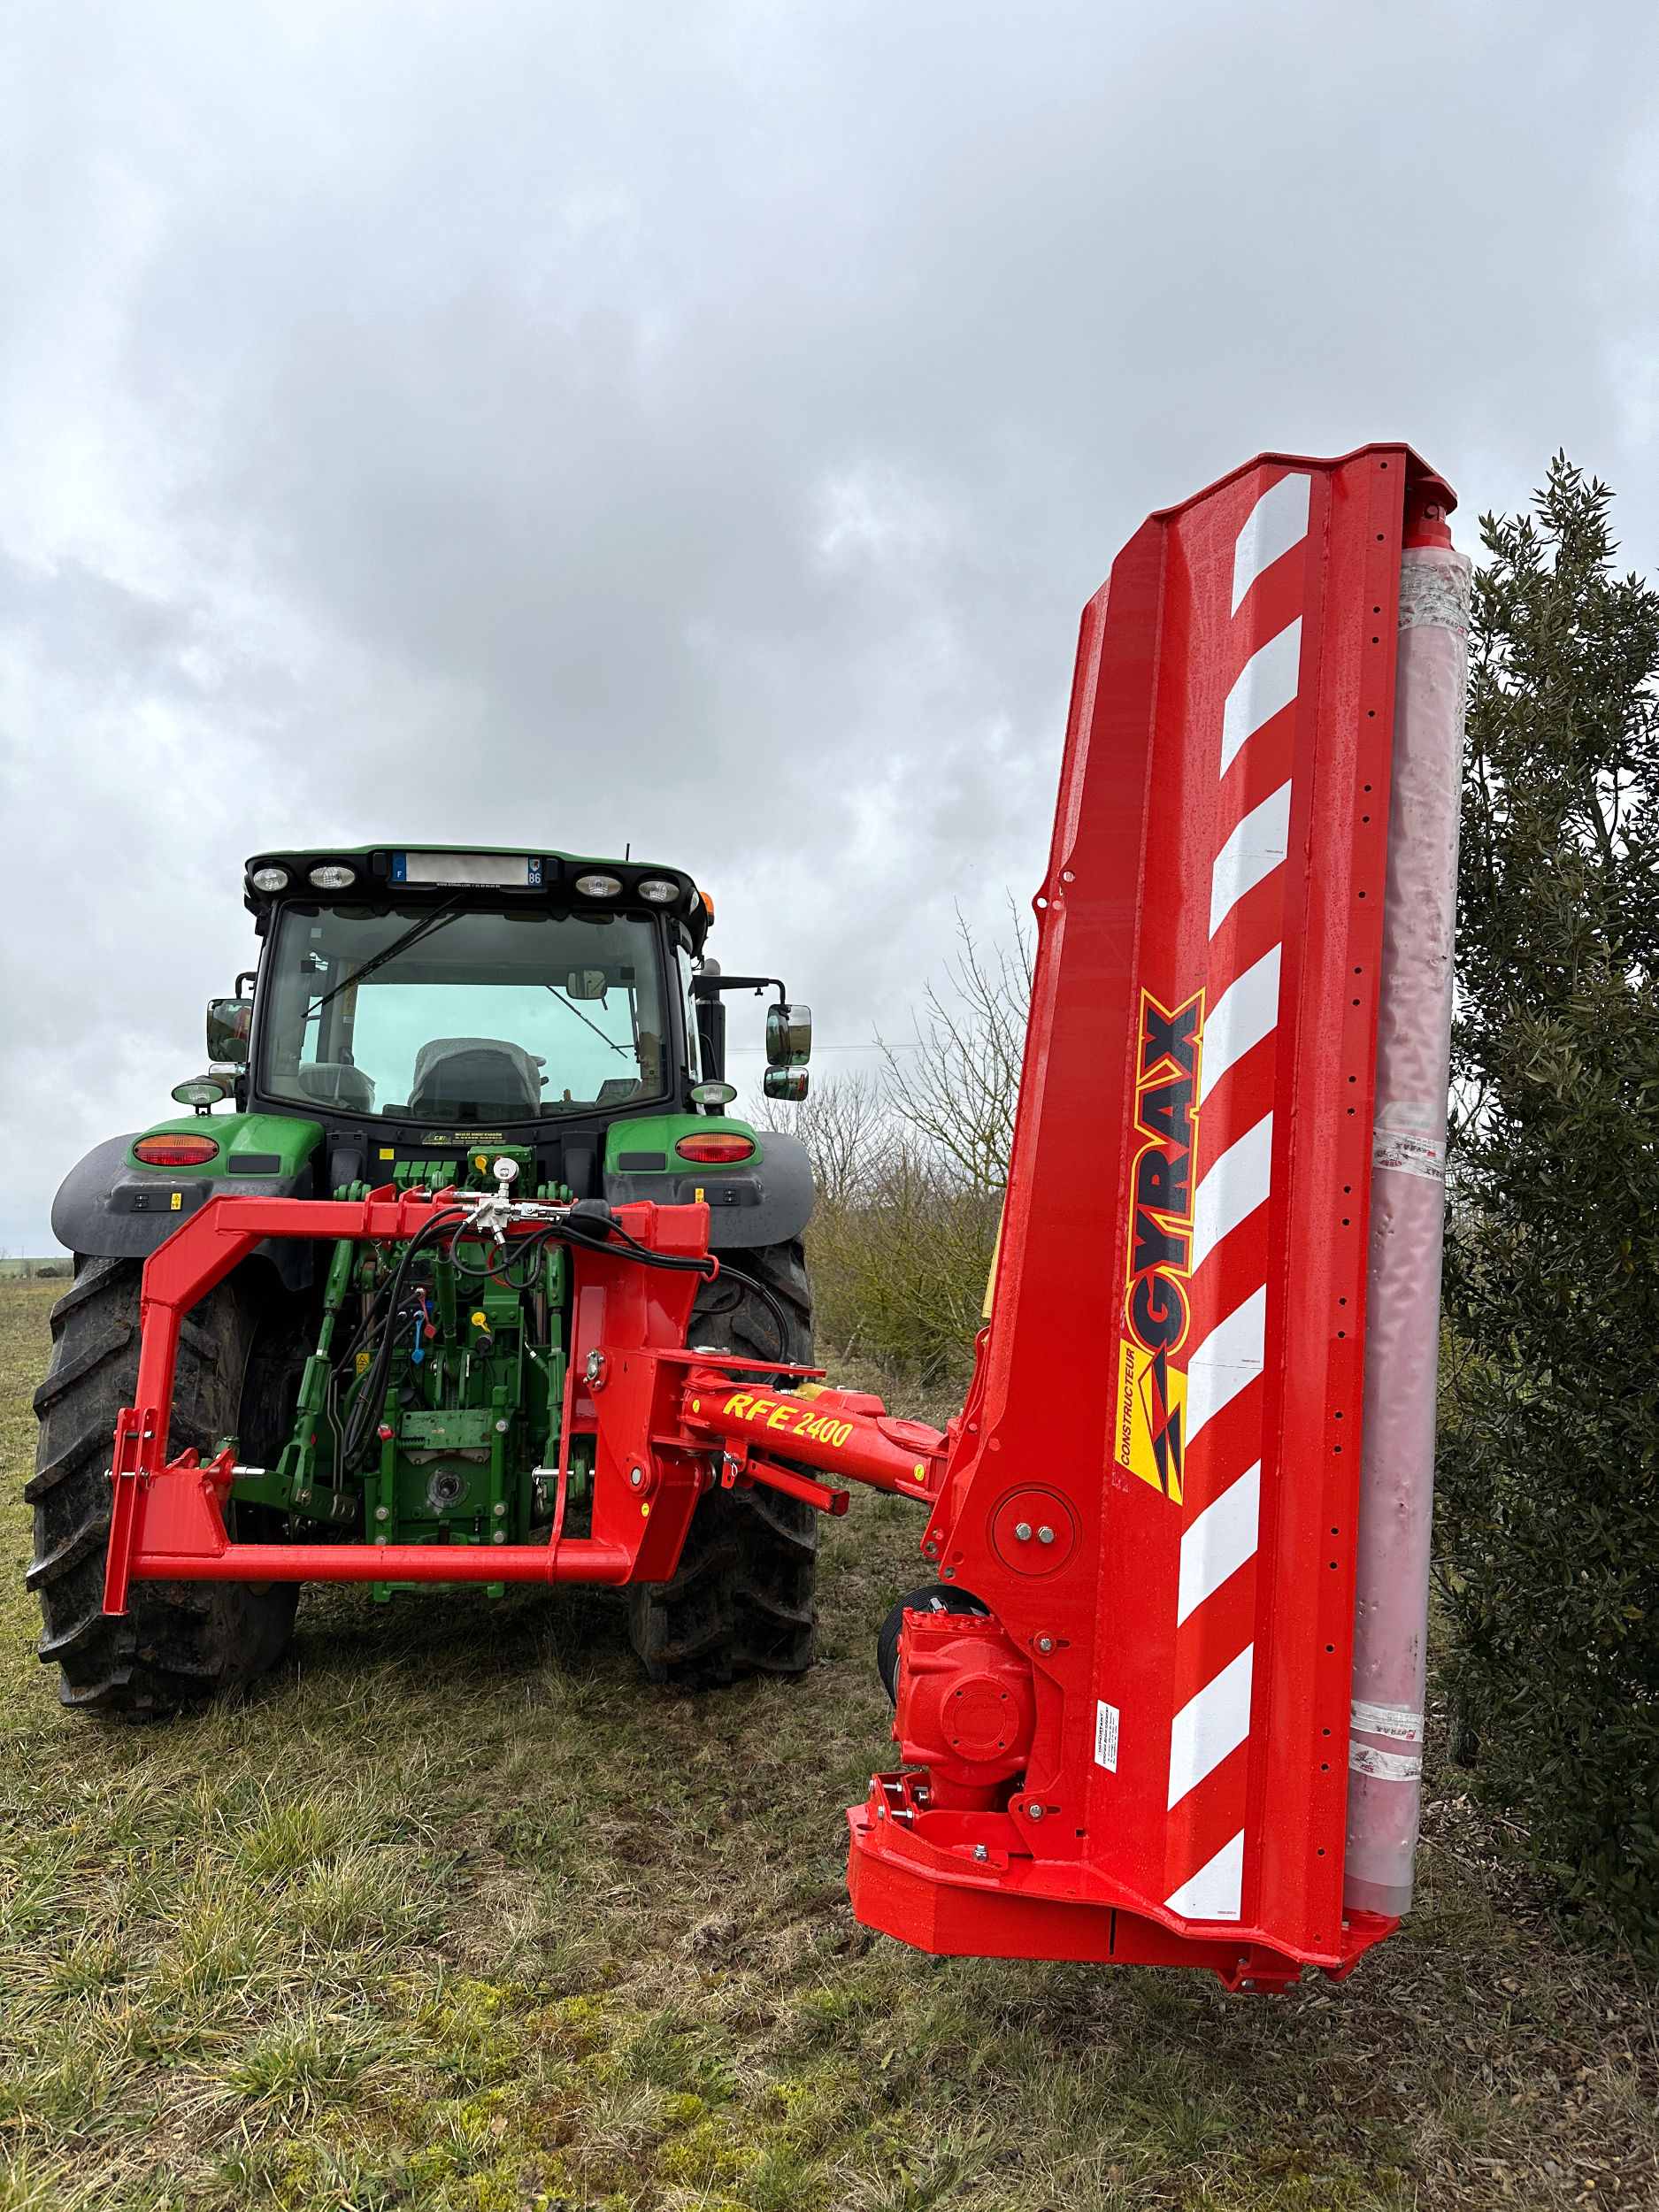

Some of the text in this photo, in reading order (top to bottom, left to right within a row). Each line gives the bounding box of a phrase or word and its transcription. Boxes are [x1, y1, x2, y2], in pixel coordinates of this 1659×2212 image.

[528, 872, 541, 884] 86
[1131, 997, 1200, 1352] GYRAX
[722, 1393, 854, 1448] RFE 2400
[1121, 1348, 1135, 1467] CONSTRUCTEUR
